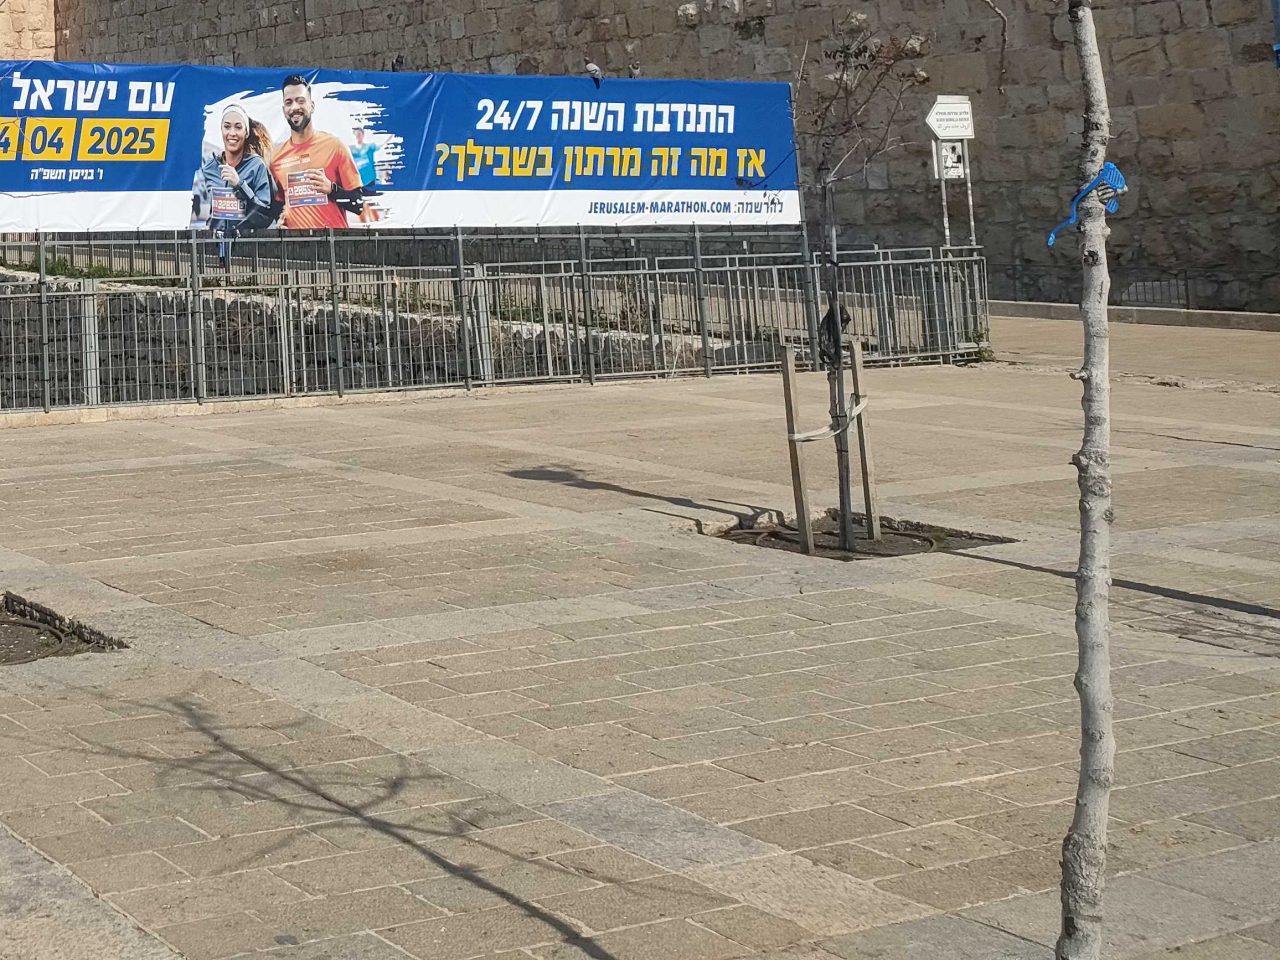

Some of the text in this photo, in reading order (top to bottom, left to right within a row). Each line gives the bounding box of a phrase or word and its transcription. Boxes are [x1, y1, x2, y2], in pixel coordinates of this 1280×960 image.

[12, 72, 118, 111] ישראל
[128, 81, 175, 112] עם
[475, 98, 735, 134] התנדבת השנה 24/7
[30, 126, 64, 155] 04
[87, 127, 155, 155] 2025
[68, 169, 95, 182] בניסן
[435, 139, 766, 182] אז מה זה מרתון בשבילך?
[588, 200, 783, 215] להרשמה: JERUSALEM-MARATHON.COM
